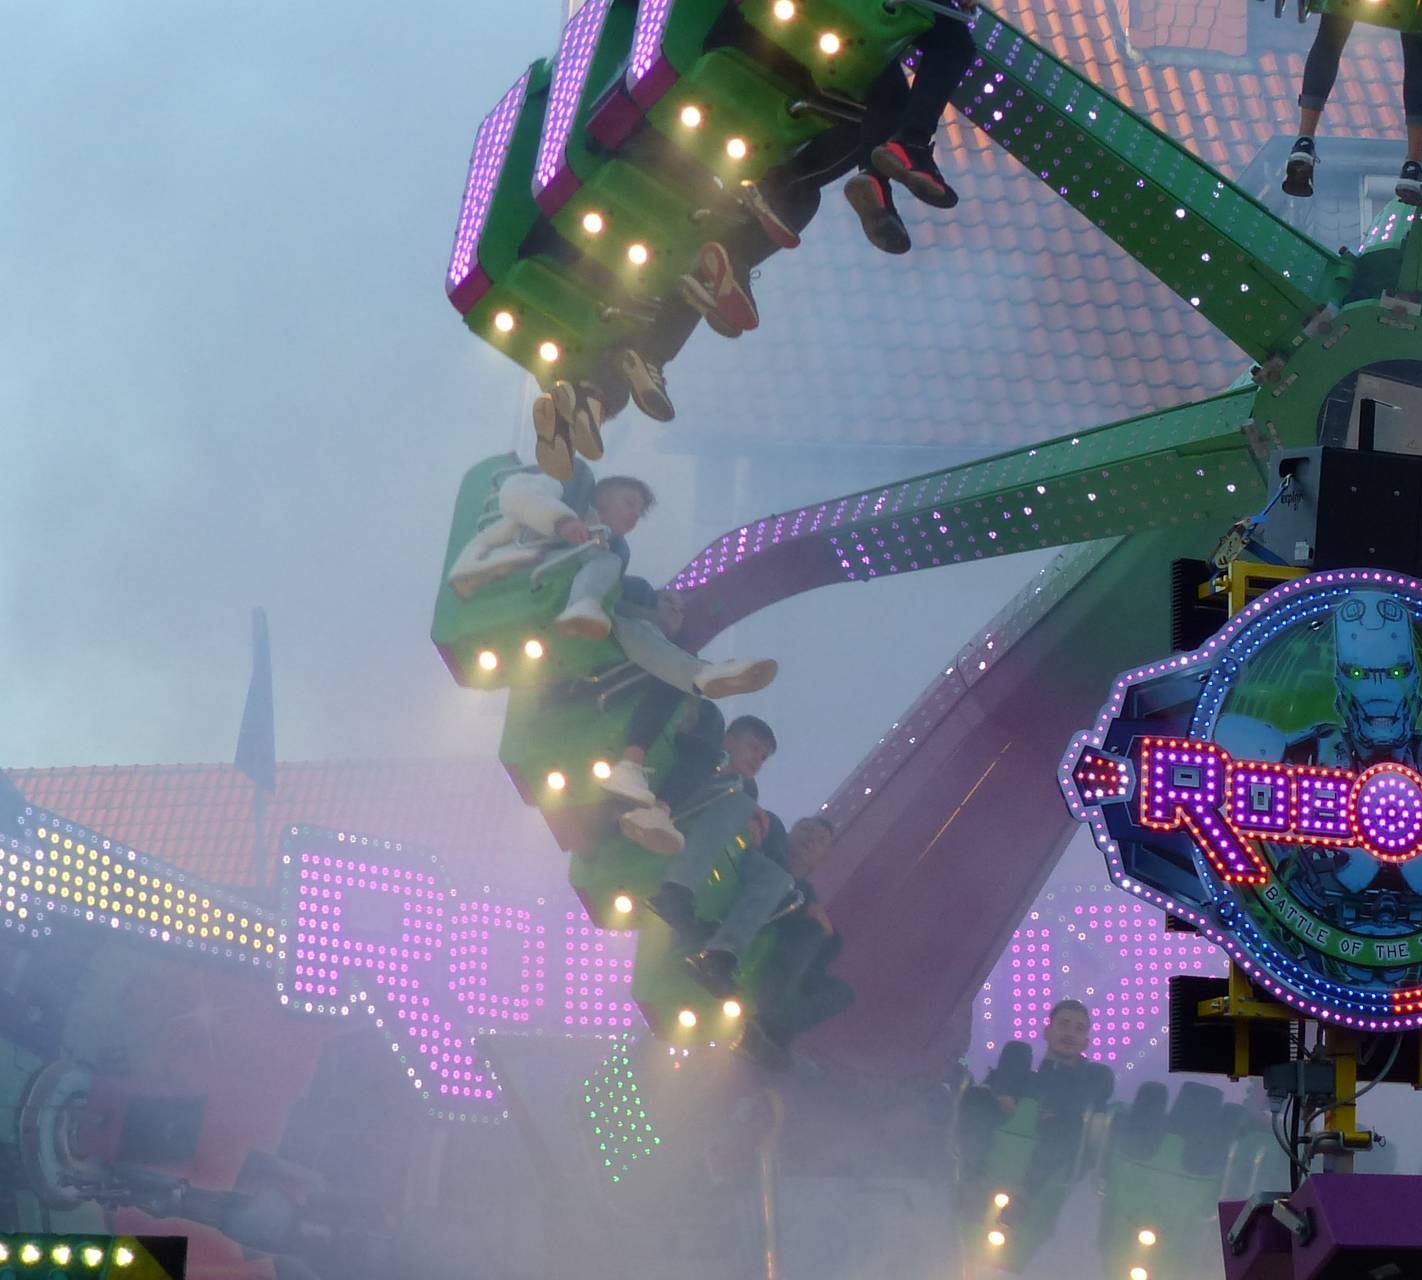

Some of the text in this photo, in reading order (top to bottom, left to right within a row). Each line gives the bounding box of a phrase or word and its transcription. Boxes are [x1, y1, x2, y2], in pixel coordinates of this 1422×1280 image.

[1264, 885, 1329, 945] BATTLE
[1340, 939, 1363, 956] OF
[1375, 943, 1409, 960] THE
